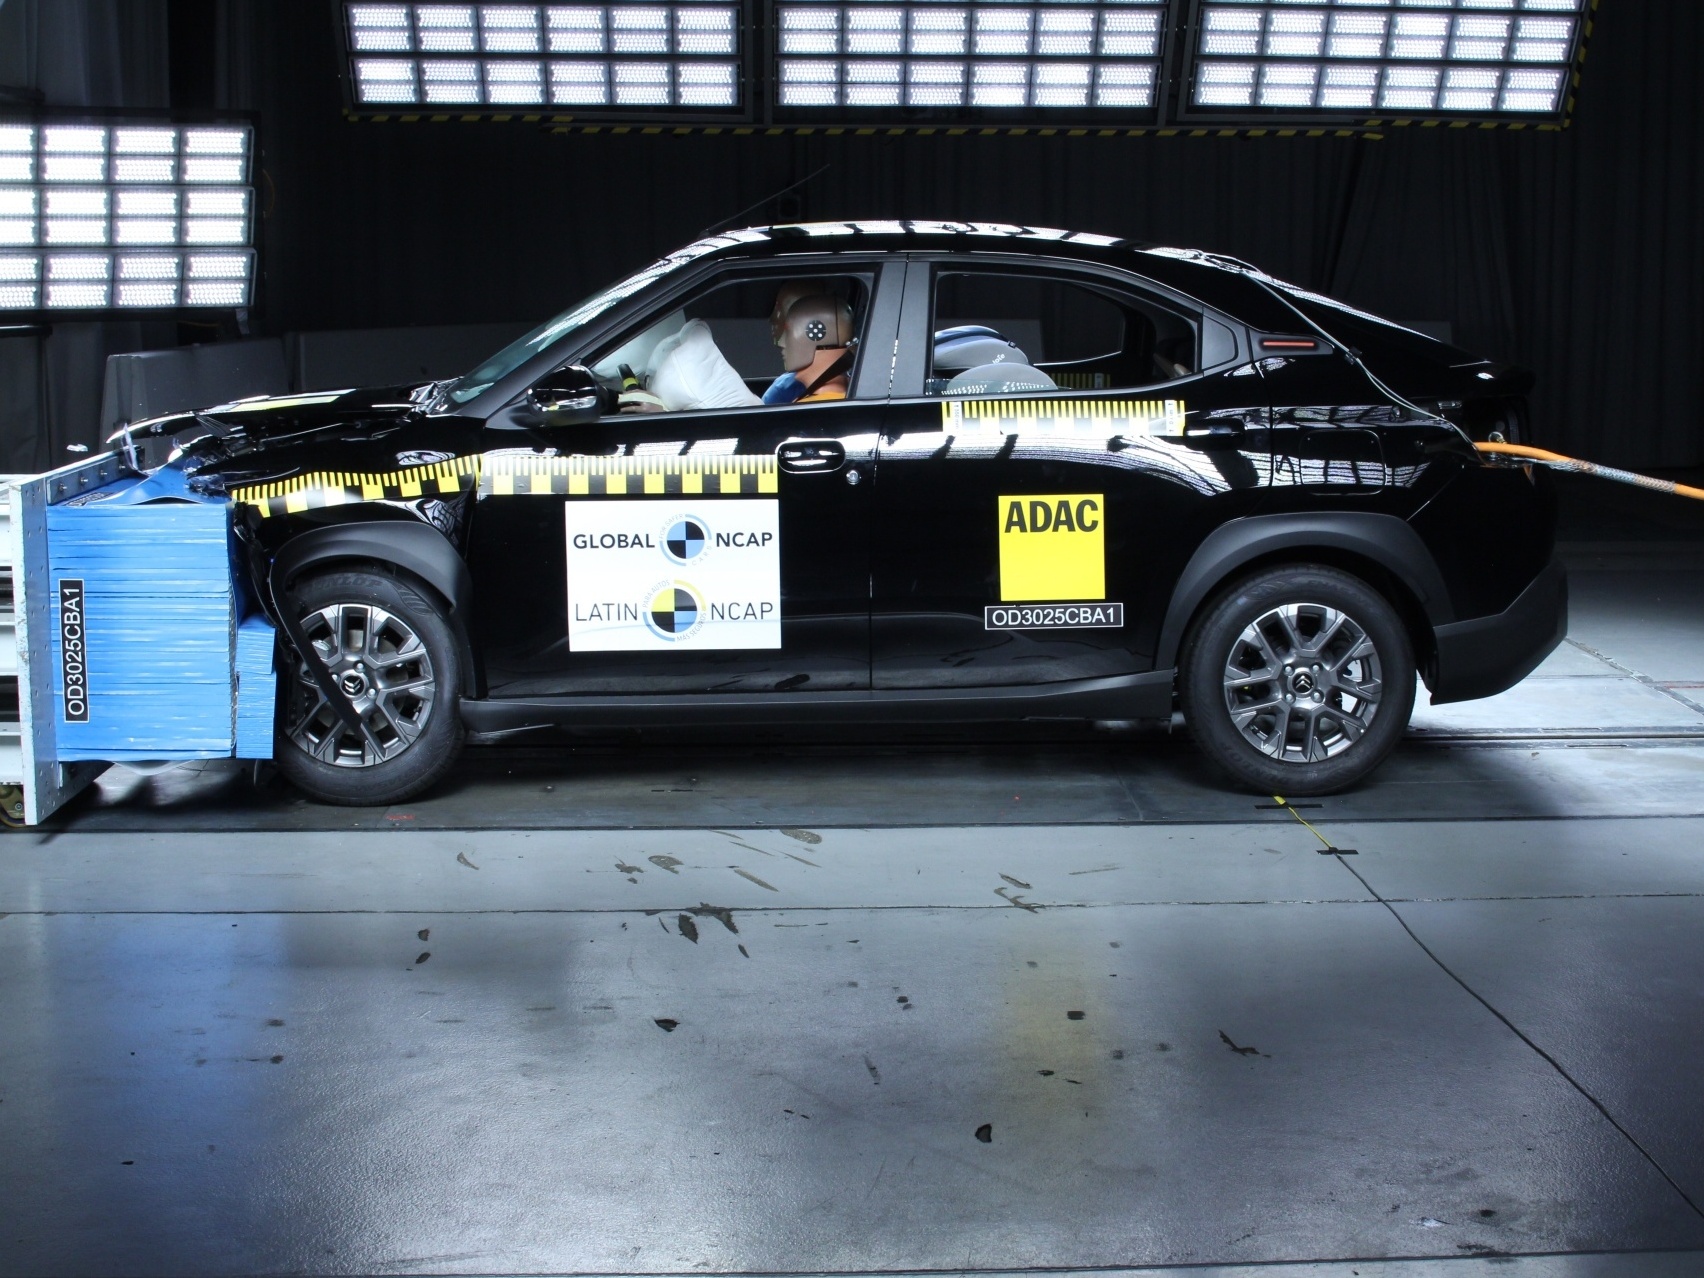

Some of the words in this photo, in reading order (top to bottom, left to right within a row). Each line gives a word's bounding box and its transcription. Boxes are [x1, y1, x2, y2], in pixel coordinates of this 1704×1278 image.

[1004, 499, 1099, 533] ADAC
[573, 533, 656, 550] GLOBAL
[716, 532, 773, 548] NCAP
[575, 603, 638, 621] LATIN
[711, 602, 774, 620] NCAP
[992, 607, 1115, 626] OD3025CBA1
[63, 588, 85, 716] OD3025CBA1
